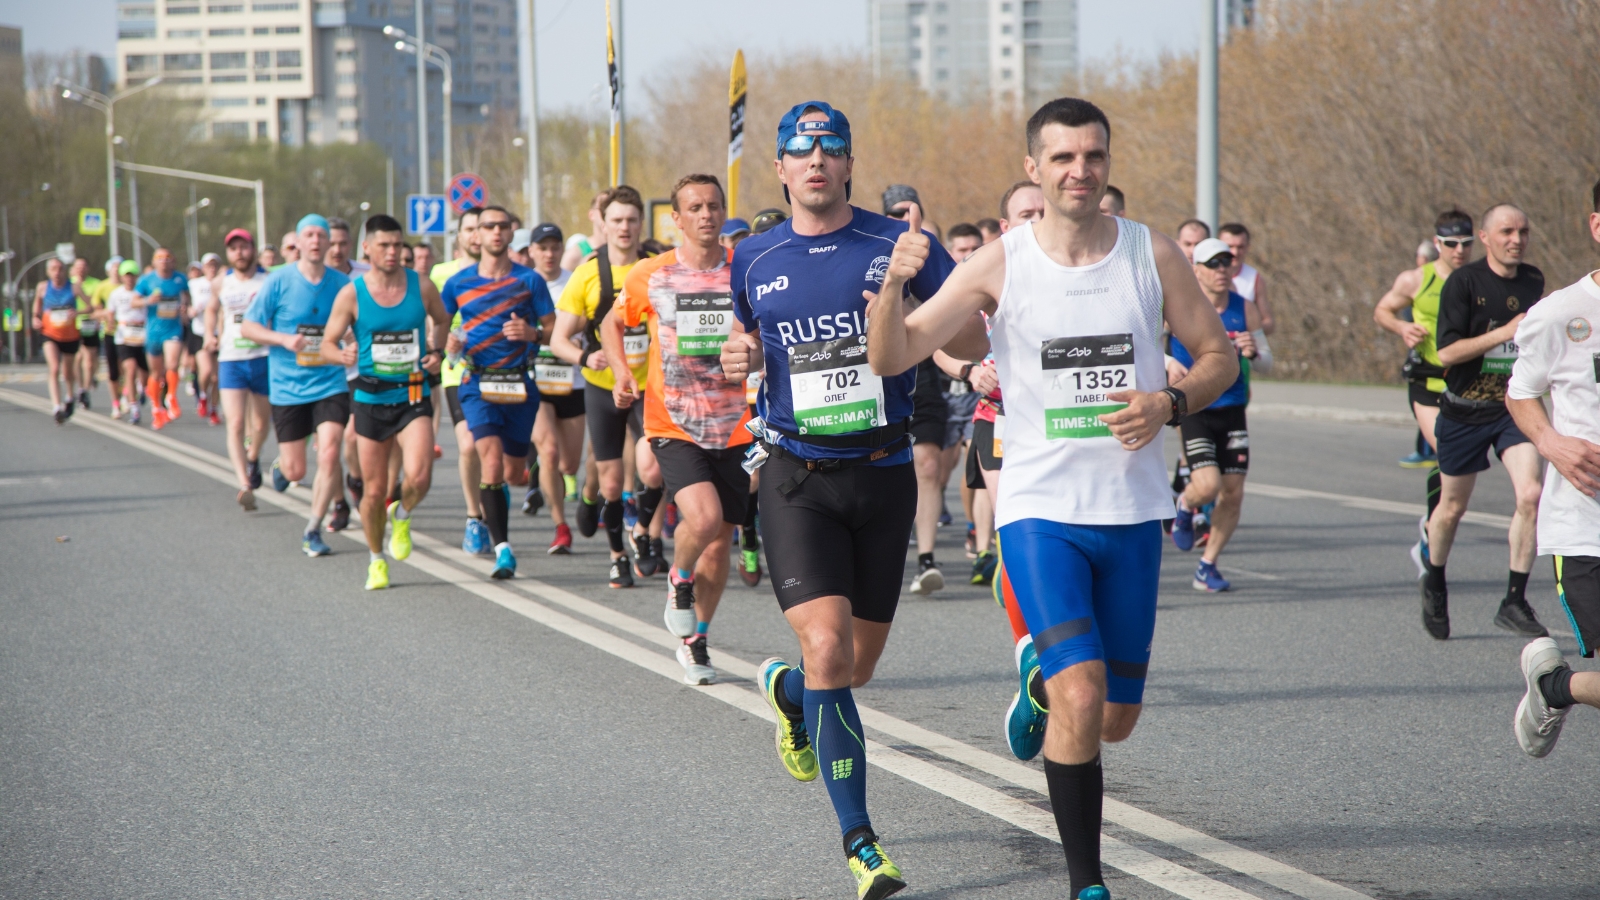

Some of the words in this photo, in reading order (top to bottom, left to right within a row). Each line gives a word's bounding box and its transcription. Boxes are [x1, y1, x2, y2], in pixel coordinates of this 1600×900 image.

[808, 245, 832, 254] CRAFT
[1065, 286, 1110, 297] noname
[699, 313, 724, 325] 800
[388, 345, 408, 354] 965
[821, 369, 861, 391] 702
[1072, 369, 1128, 390] 1352
[824, 392, 848, 403] ОЛЕГ
[1075, 393, 1109, 403] ПАВЕЛ
[832, 771, 852, 781] cep
